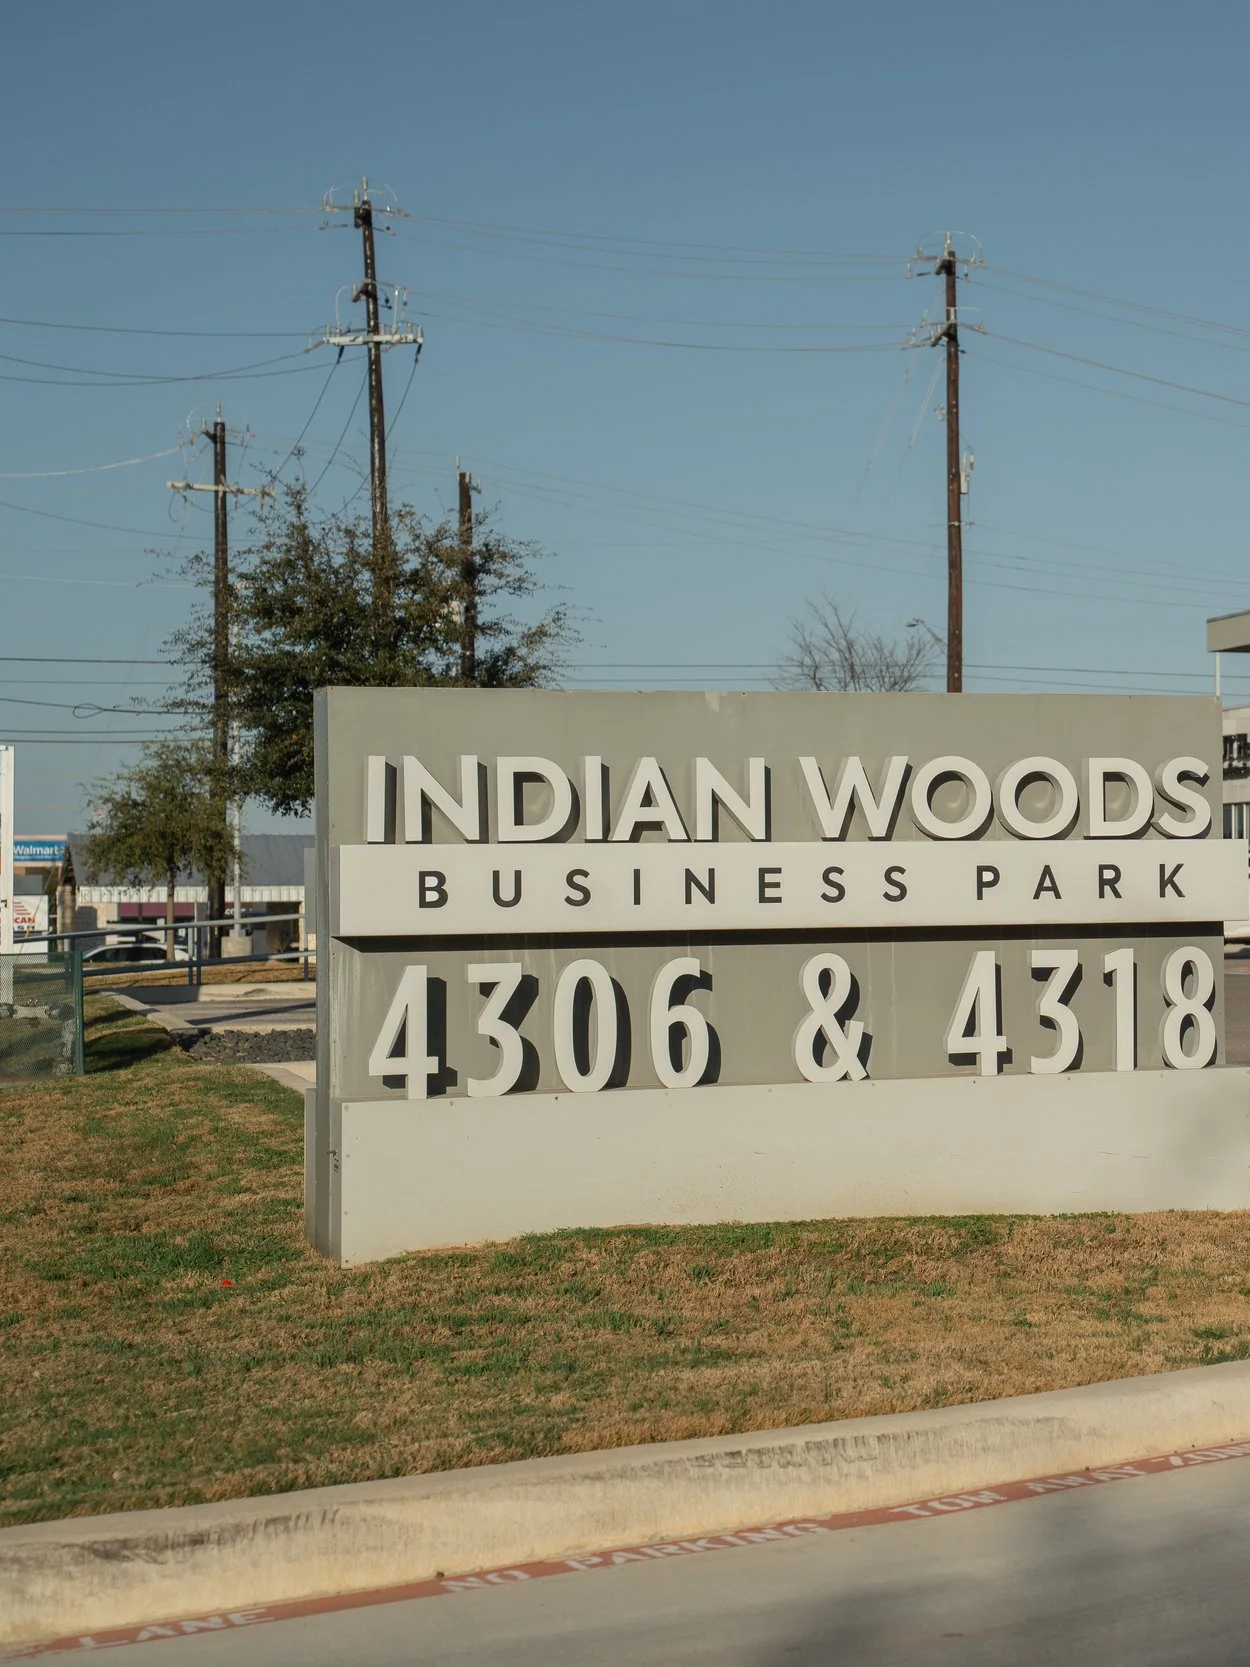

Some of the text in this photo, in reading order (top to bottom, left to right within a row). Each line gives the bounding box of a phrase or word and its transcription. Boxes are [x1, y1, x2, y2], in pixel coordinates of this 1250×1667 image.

[366, 755, 1212, 842] INDIAN WOODS
[14, 845, 59, 855] Walmart
[418, 863, 1186, 909] BUSINESS PARK
[368, 946, 1216, 1100] 4306 & 4318
[439, 1569, 531, 1593] NO
[562, 1523, 831, 1571] PARKING
[888, 1490, 1008, 1516] TOW
[1025, 1466, 1148, 1493] AWAY
[78, 1608, 275, 1649] LANE
